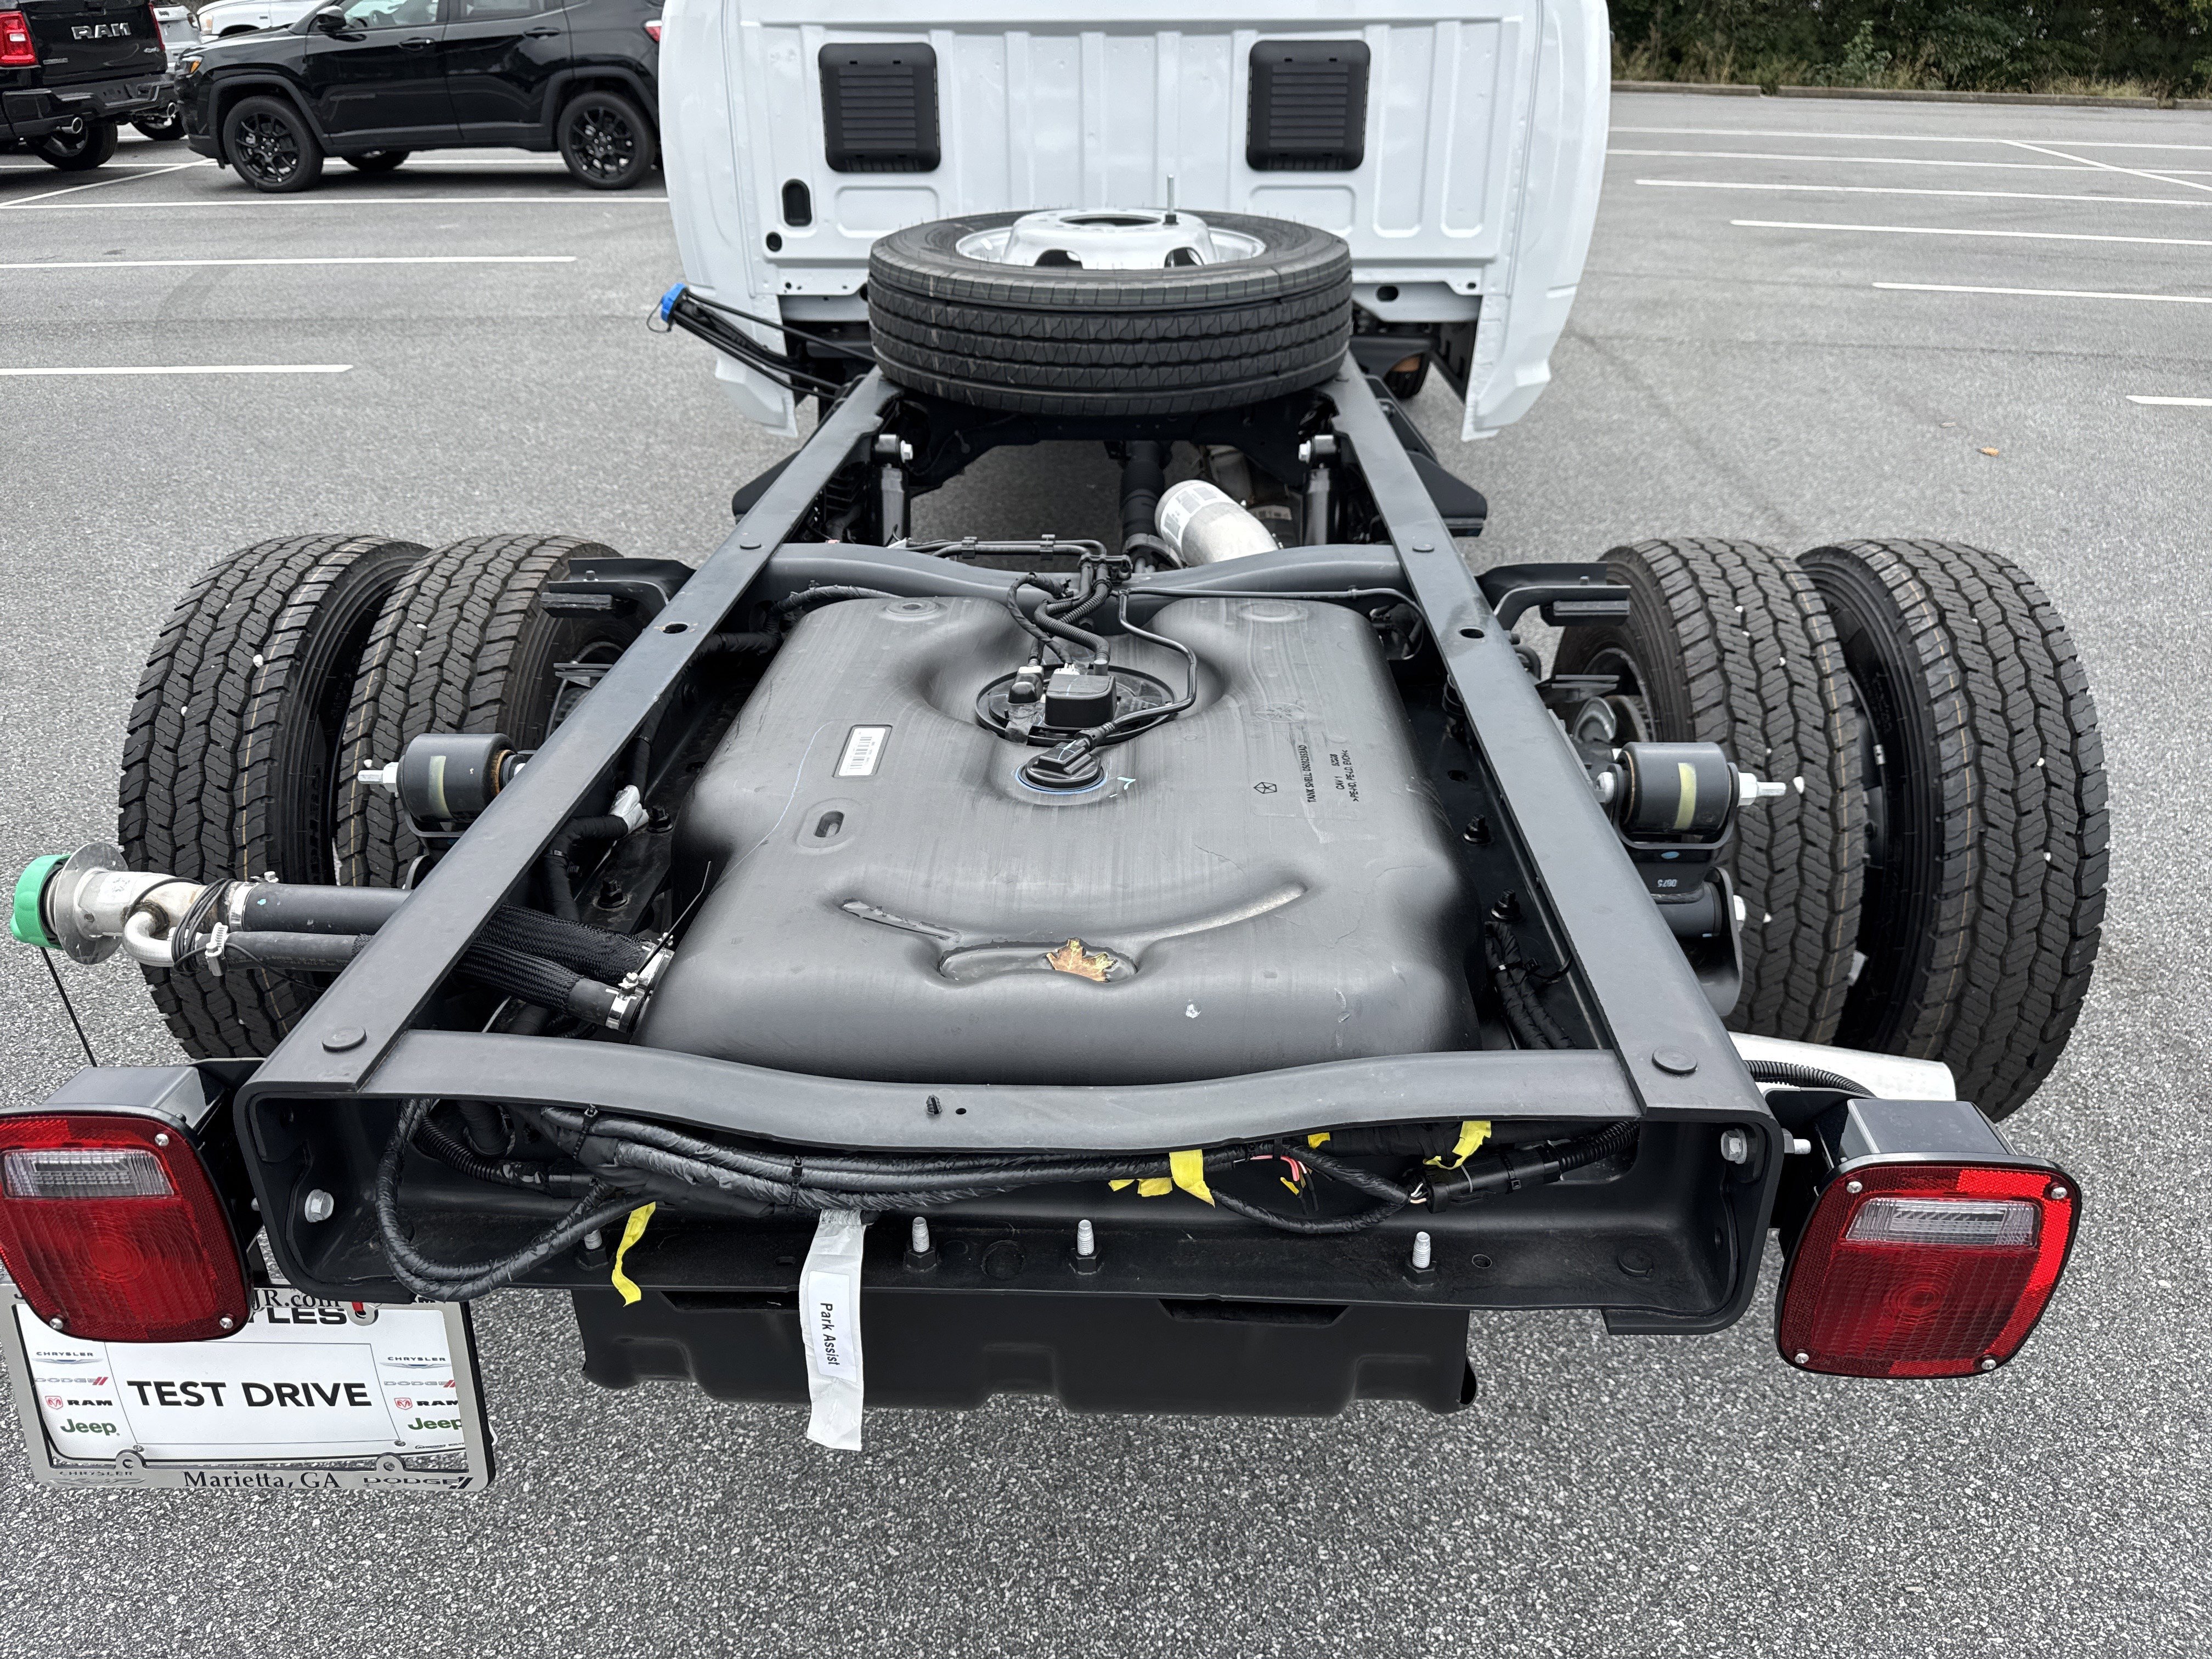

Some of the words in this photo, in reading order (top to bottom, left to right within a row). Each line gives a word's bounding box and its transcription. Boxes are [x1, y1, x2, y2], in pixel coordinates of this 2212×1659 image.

[71, 22, 132, 40] RAM
[1334, 779, 1345, 790] CAV
[1306, 788, 1317, 803] TANK
[820, 1302, 834, 1330] Park
[822, 1334, 840, 1366] Assist
[127, 1380, 227, 1407] TEST
[241, 1381, 373, 1408] DRIVE
[60, 1418, 117, 1436] Jeep
[184, 1471, 294, 1489] Marietta,
[299, 1471, 342, 1489] GA
[363, 1477, 461, 1485] DODGE
